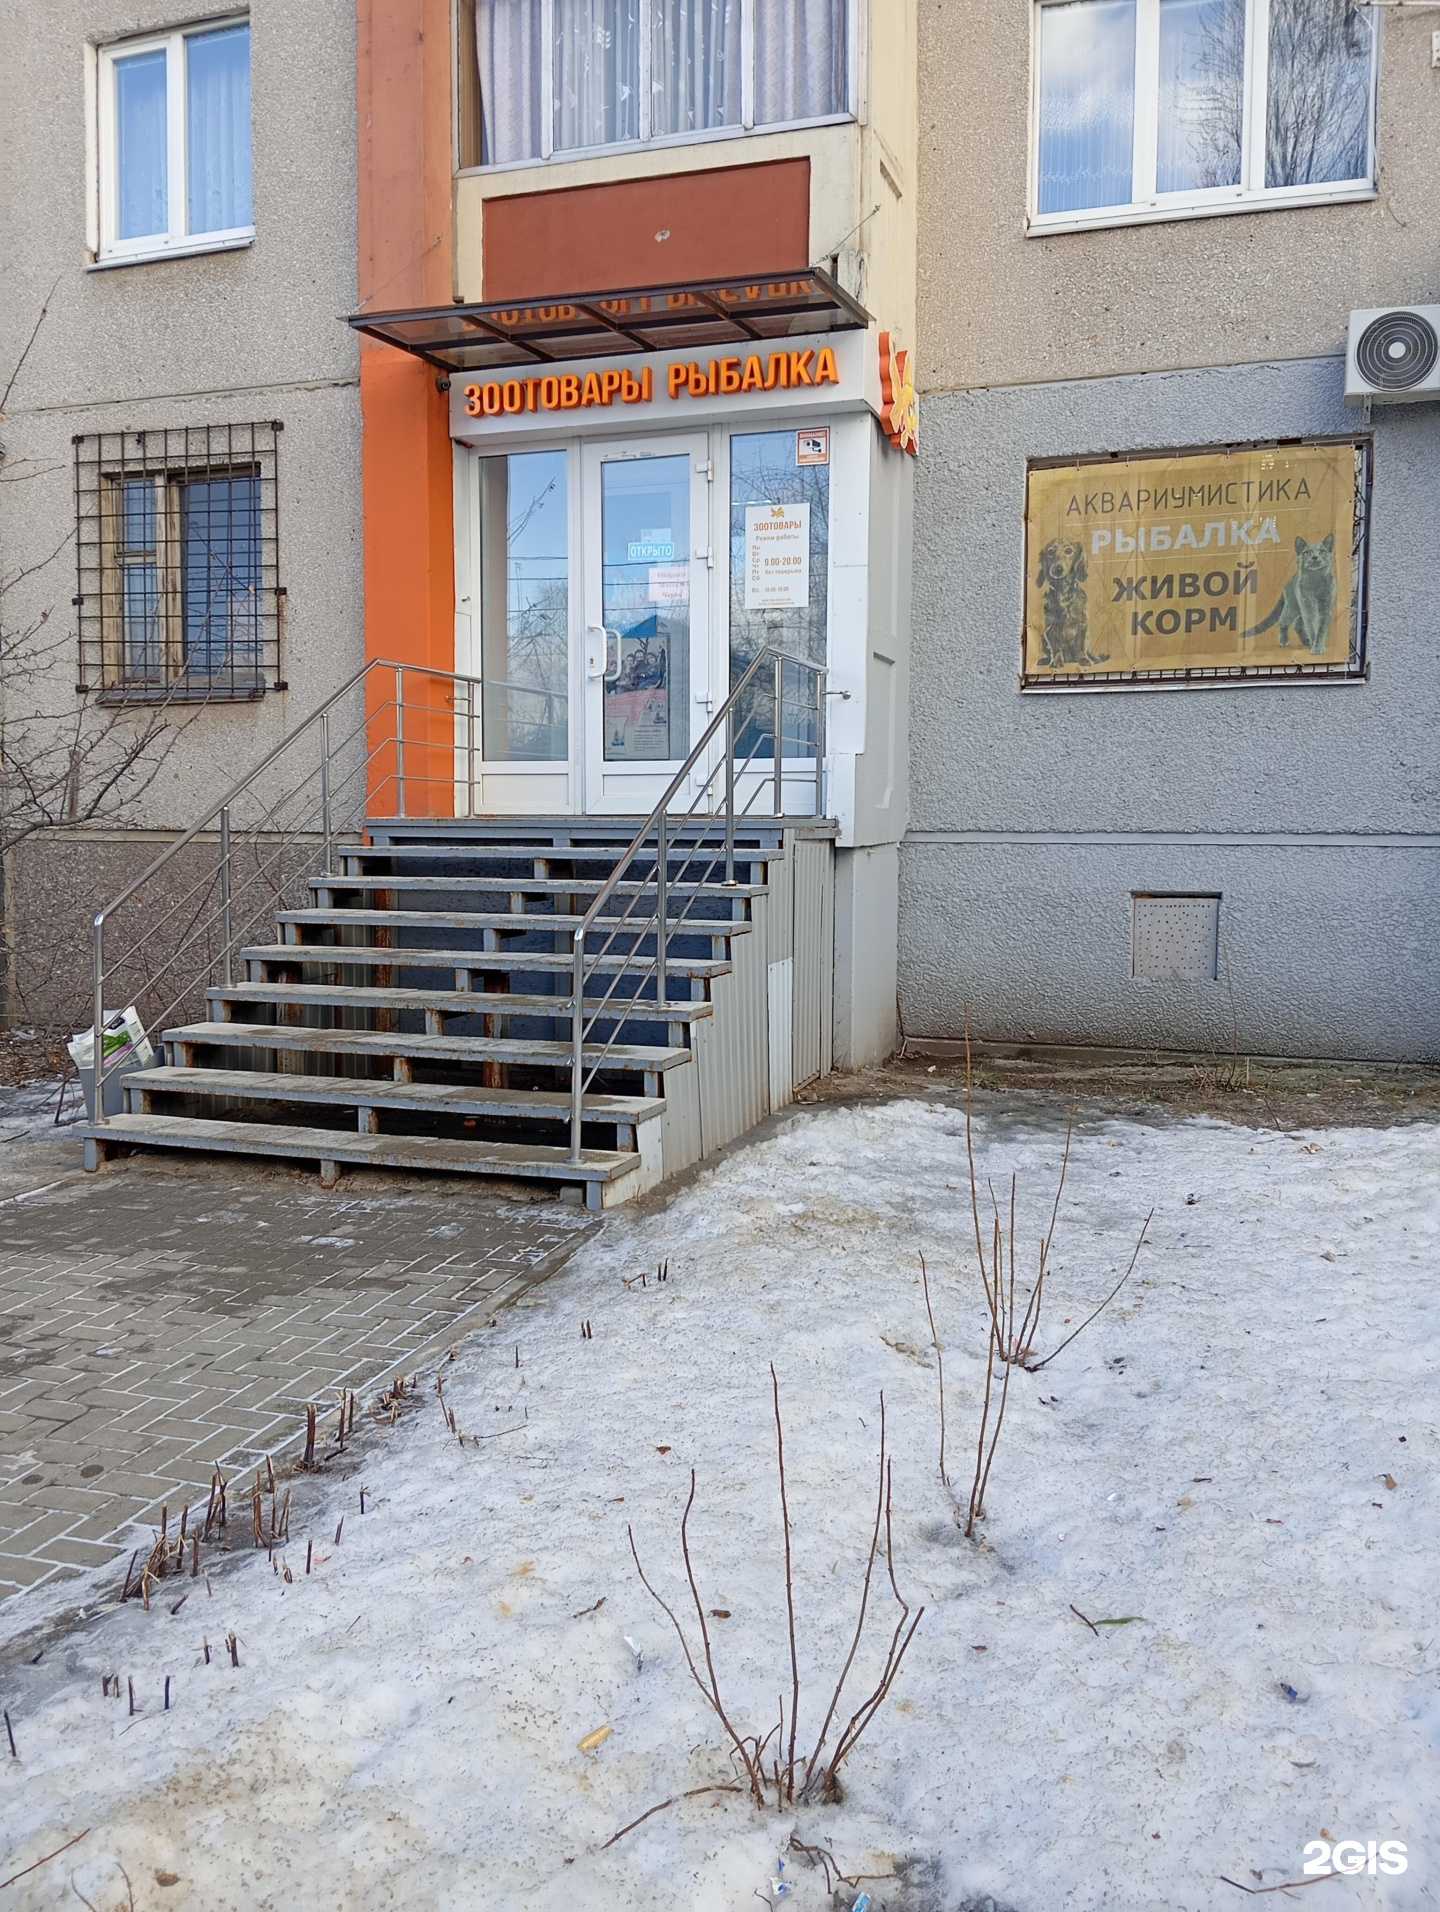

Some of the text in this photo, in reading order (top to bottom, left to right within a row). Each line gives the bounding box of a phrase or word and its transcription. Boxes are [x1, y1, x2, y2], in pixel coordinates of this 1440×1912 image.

[464, 347, 839, 417] ЗООТОВАРЫ РЫБАЛКА
[1066, 477, 1312, 516] АКВАРИУМИСТИКА
[753, 520, 801, 531] ЗООТОВАРЫ
[1091, 518, 1280, 554] РЫБАЛКА
[630, 545, 673, 557] ОТКРЫТО
[1111, 561, 1258, 602] ЖИВОЙ
[1131, 606, 1237, 635] КОРМ
